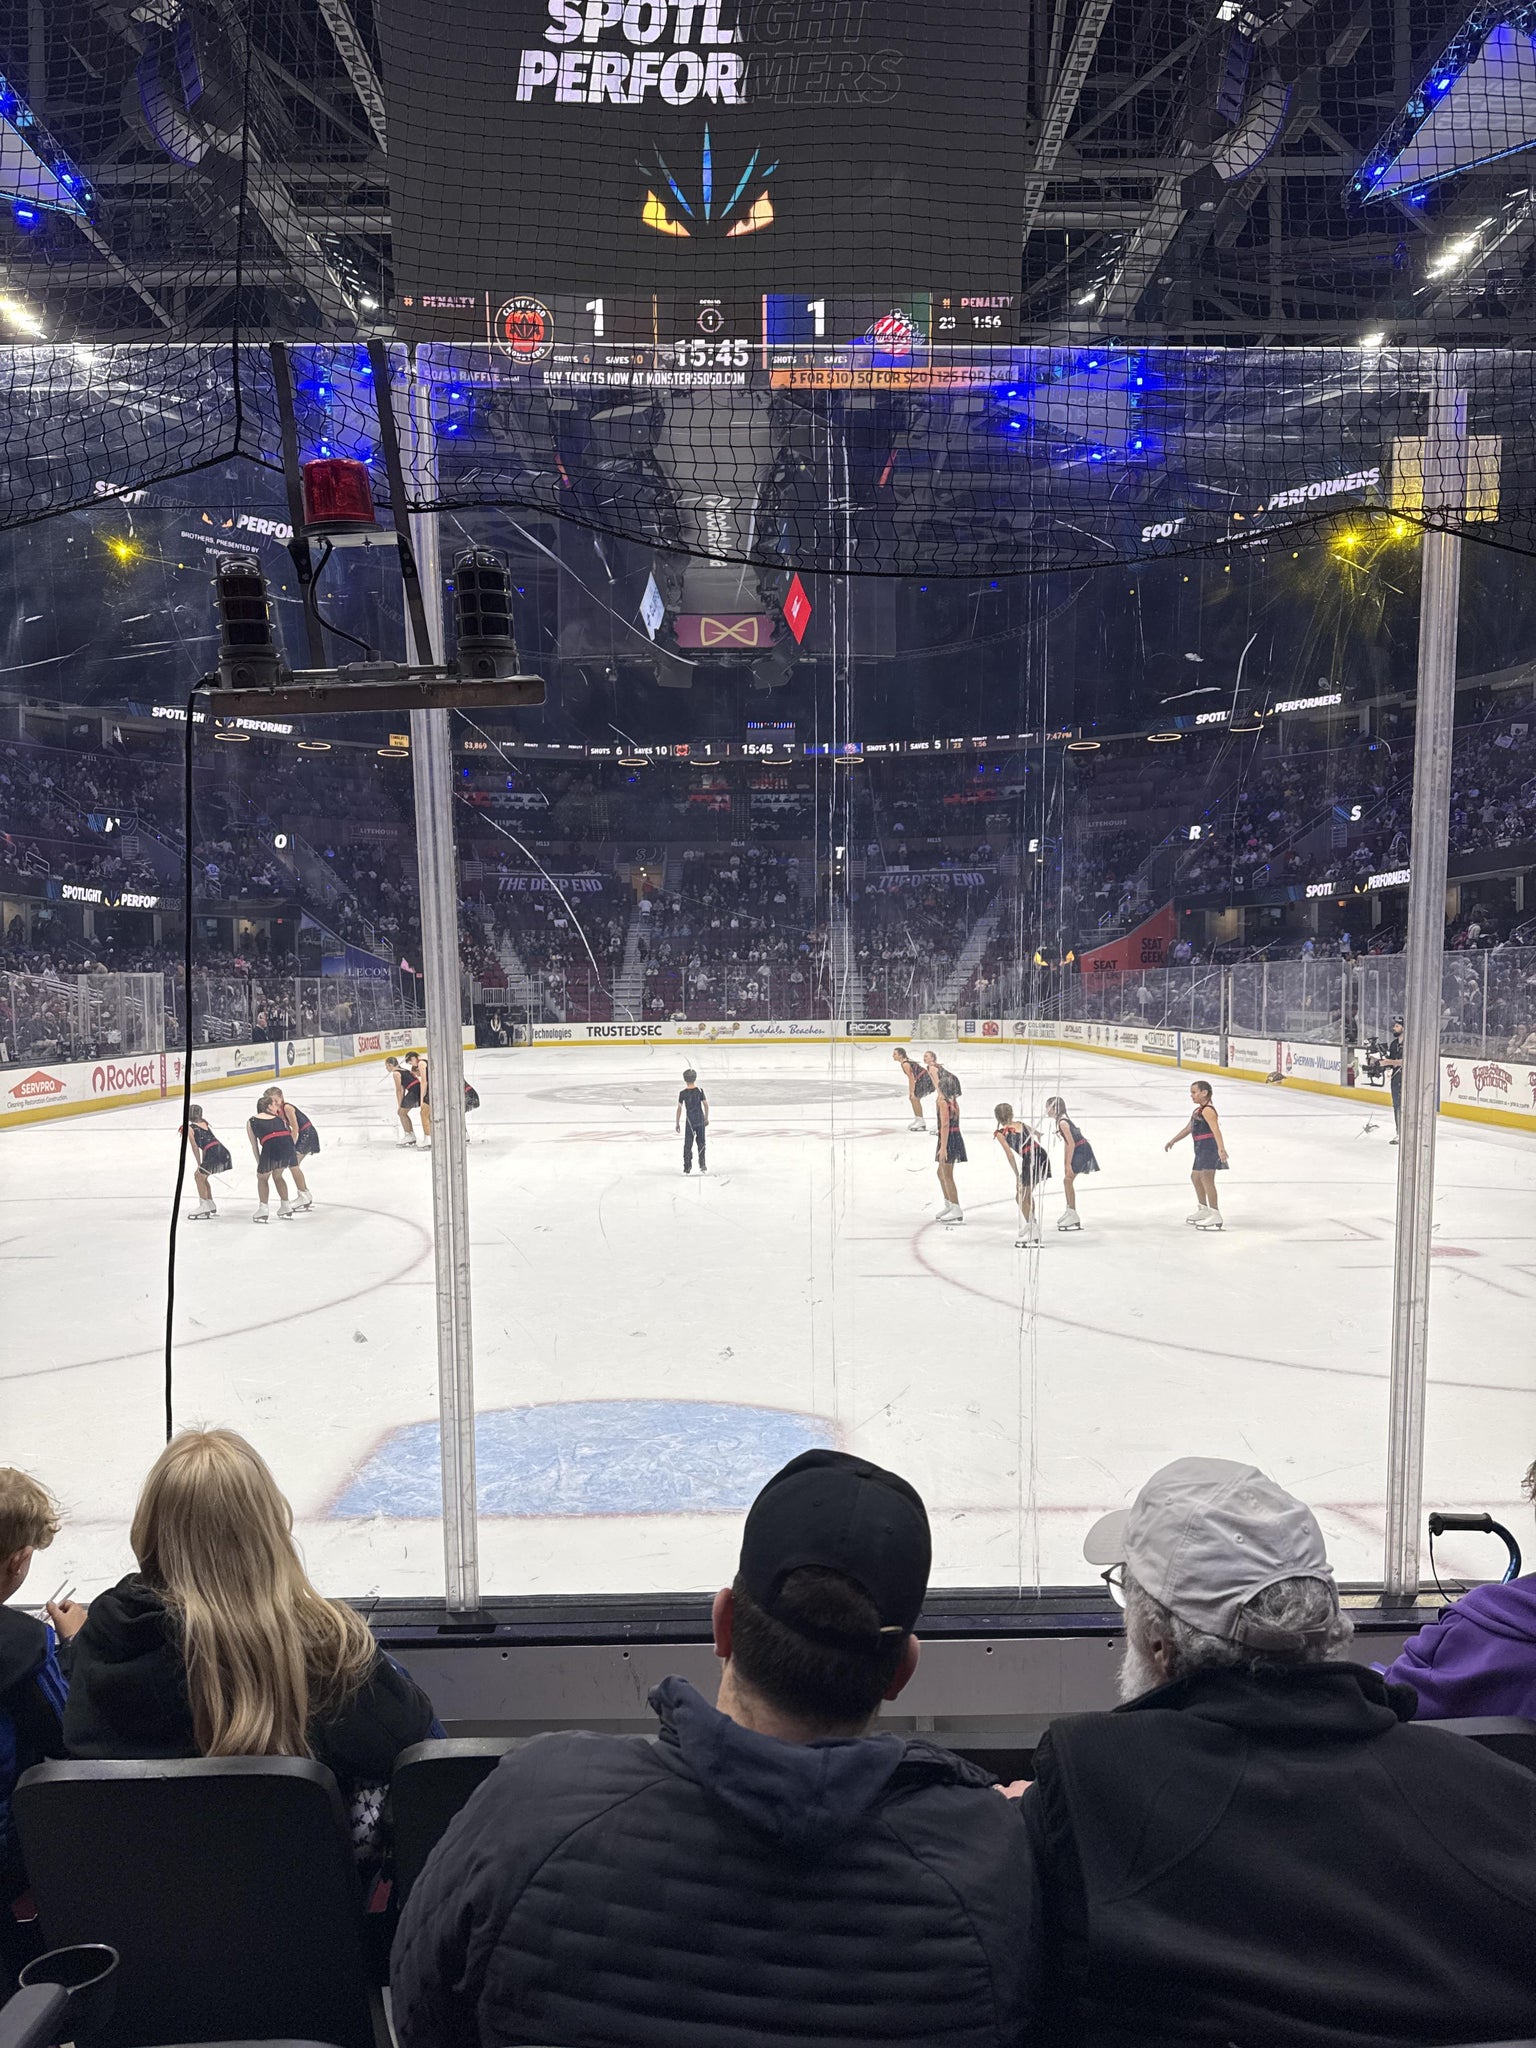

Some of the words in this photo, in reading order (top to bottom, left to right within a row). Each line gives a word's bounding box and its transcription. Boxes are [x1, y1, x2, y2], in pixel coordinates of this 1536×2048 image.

[422, 295, 476, 308] PENALTY
[960, 295, 1014, 308] PENALTY
[586, 298, 604, 337] 1
[707, 315, 713, 326] 1
[808, 298, 825, 337] 1
[938, 316, 956, 329] 23
[972, 315, 1002, 328] 1:56
[553, 355, 578, 364] SHOTS
[583, 355, 590, 364] 6
[605, 355, 630, 364] SAVES
[675, 338, 749, 367] 15:45
[772, 355, 797, 364] SHOTS
[544, 371, 562, 385] BUY
[565, 371, 605, 385] TICKETS
[607, 371, 630, 385] NOW
[632, 371, 645, 385] AT
[800, 372, 824, 384] FOR
[827, 372, 849, 384] $10
[858, 372, 873, 384] 50
[877, 372, 901, 384] FOR
[904, 372, 927, 384] $20
[961, 370, 987, 383] FOR
[1267, 467, 1380, 512] PERFORMERS
[216, 538, 251, 552] PRESENTED
[1275, 693, 1342, 713] PERFORMERS
[616, 746, 623, 756] 6
[655, 746, 667, 756] 10
[705, 744, 711, 756] 1
[741, 744, 774, 755] 15:45
[822, 743, 829, 754] 1
[866, 744, 886, 752] SHOTS
[889, 742, 900, 752] 11
[910, 742, 930, 750] SAVES
[934, 740, 942, 750] 5
[1350, 805, 1362, 821] S
[1189, 825, 1201, 840] R
[274, 834, 287, 849] O
[1028, 838, 1039, 852] E
[835, 846, 845, 859] T
[499, 877, 527, 892] THE
[530, 878, 569, 892] DEEP
[572, 878, 603, 892] END
[953, 873, 985, 886] END
[1367, 868, 1411, 890] PERFORMERS
[62, 884, 102, 903] SPOTLIGHT
[1141, 937, 1163, 950] SEAT
[1140, 951, 1164, 964] GEEK
[348, 967, 391, 977] LECOM
[1093, 960, 1118, 970] SEAT
[586, 1025, 662, 1037] TRUSTEDSEC
[358, 1033, 381, 1053] SEATGEEK
[1293, 1053, 1341, 1072] SHERWIN-WILLIAMS
[106, 1061, 155, 1091] Rocket
[21, 1080, 56, 1095] SERVPRO
